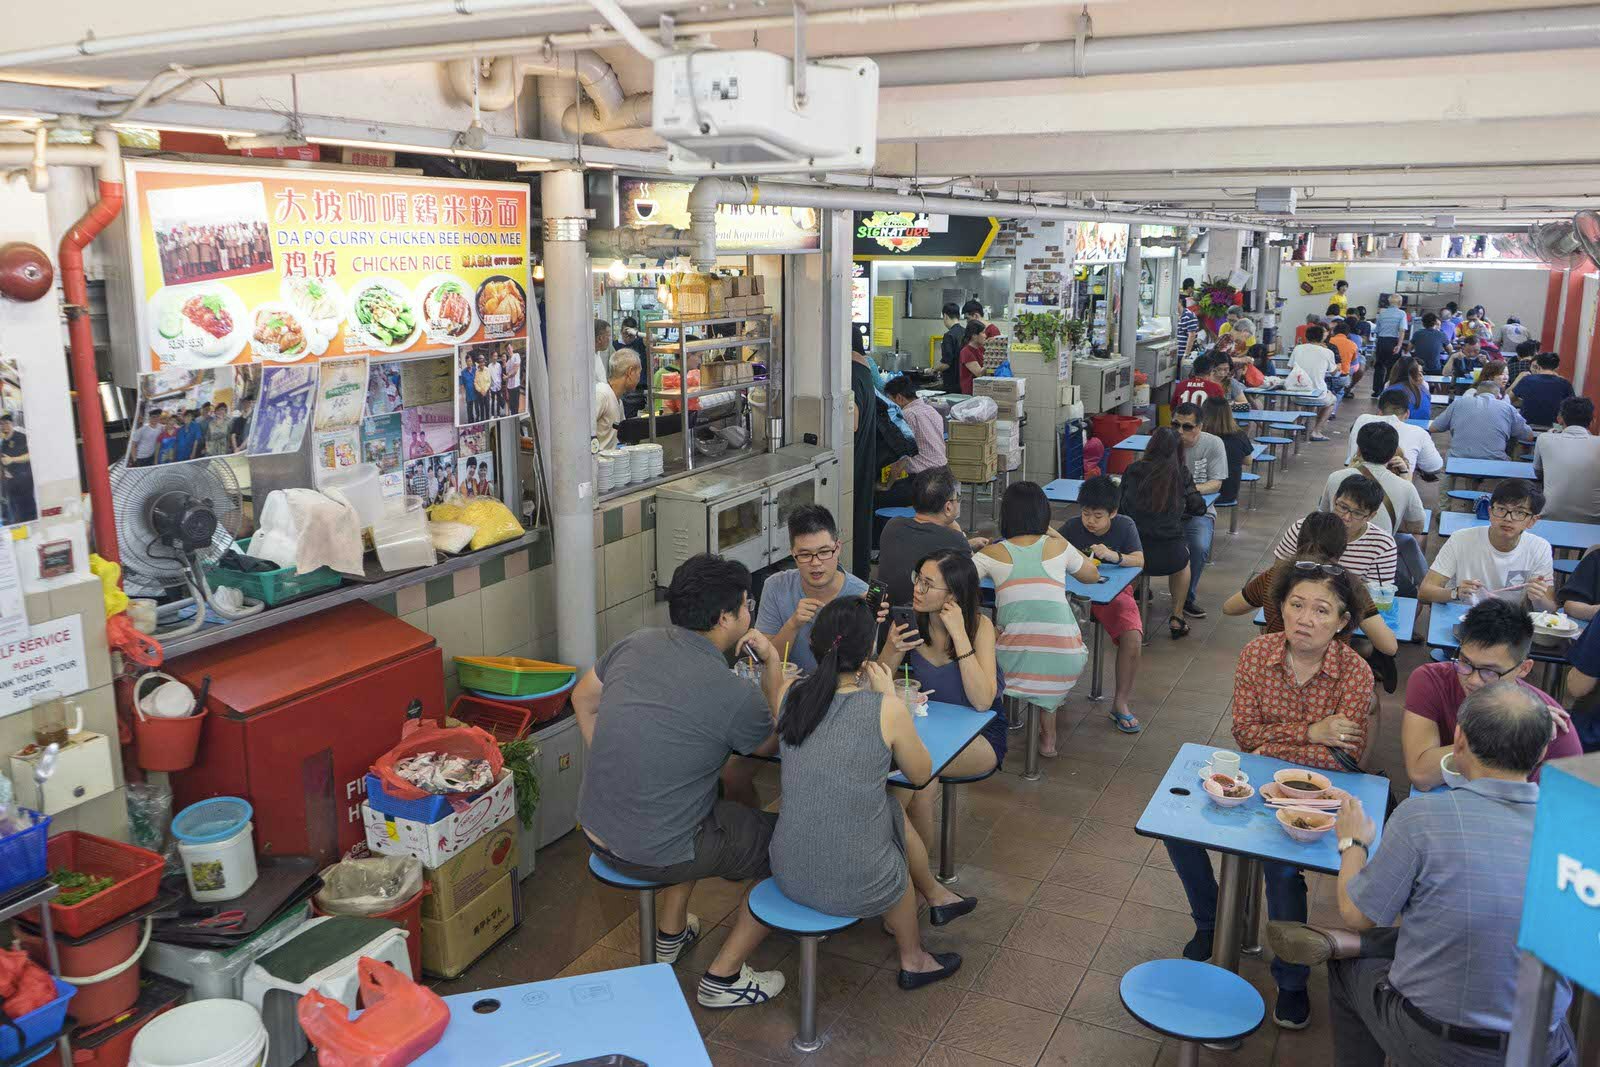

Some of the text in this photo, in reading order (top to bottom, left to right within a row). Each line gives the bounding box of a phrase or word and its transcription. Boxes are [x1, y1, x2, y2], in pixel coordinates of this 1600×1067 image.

[277, 230, 521, 246] DA PO CURRY CHICKEN BEE HOON MEE
[857, 226, 930, 238] SIGNATURE
[283, 250, 337, 279] 鸡饭
[352, 256, 419, 273] CHICKEN
[422, 255, 452, 271] RICE
[1180, 389, 1208, 407] 10
[19, 629, 71, 654] SERVICE
[13, 656, 46, 671] PLEASE
[17, 674, 34, 683] YOU
[36, 666, 52, 678] FOR
[54, 659, 77, 672] YOUR
